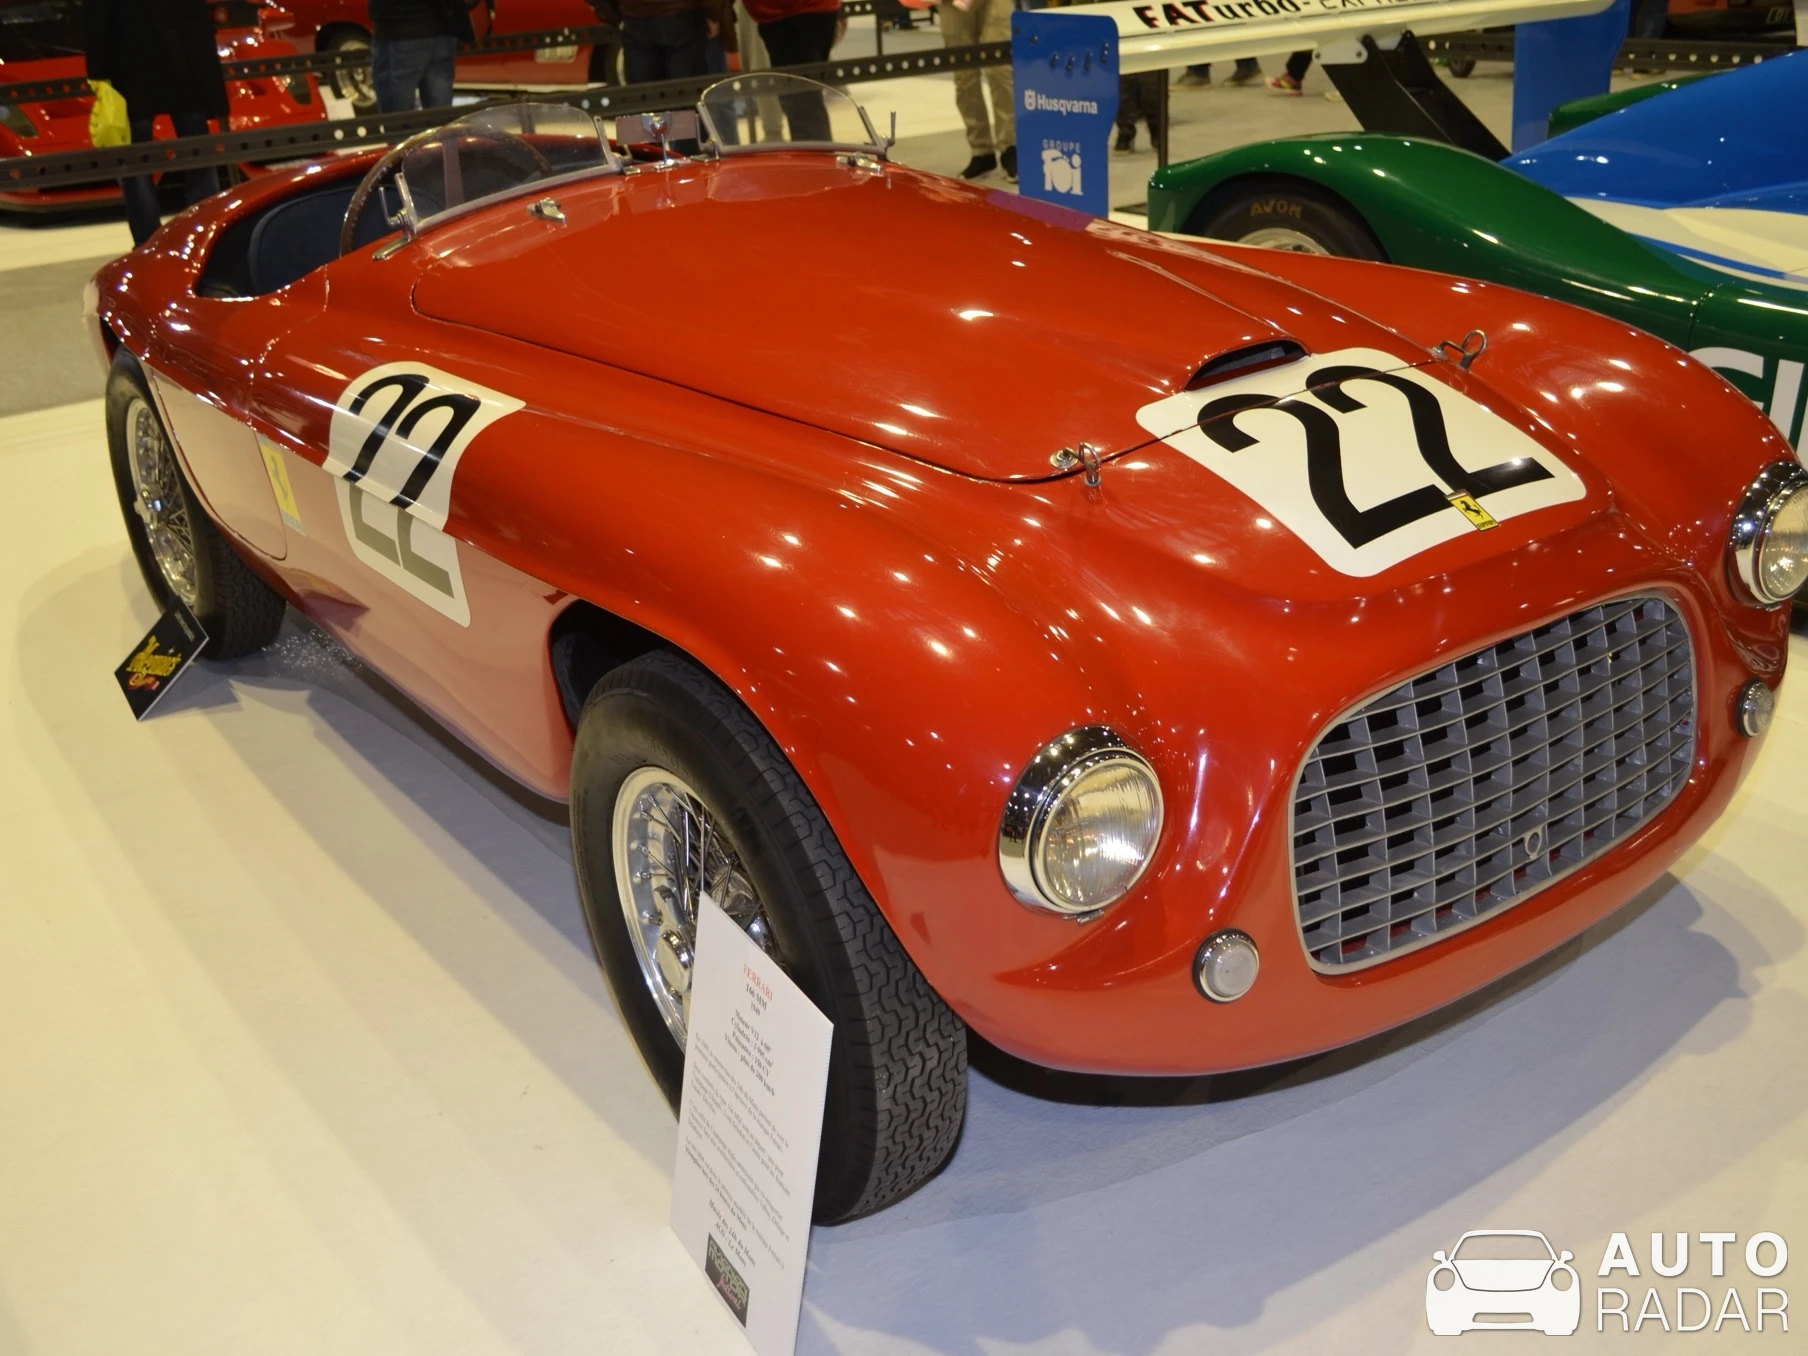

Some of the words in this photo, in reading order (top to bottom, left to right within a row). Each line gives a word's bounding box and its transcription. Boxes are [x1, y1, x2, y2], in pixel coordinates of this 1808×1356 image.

[1037, 94, 1098, 116] Husqvarna
[1042, 139, 1080, 153] GROUPE
[1250, 198, 1302, 219] AVON
[1197, 365, 1555, 549] 22
[343, 374, 482, 599] 22
[743, 964, 772, 1000] FERRARI
[745, 983, 755, 997] 166
[756, 992, 766, 1010] MM
[750, 1001, 760, 1015] 1949
[740, 1054, 749, 1067] plus
